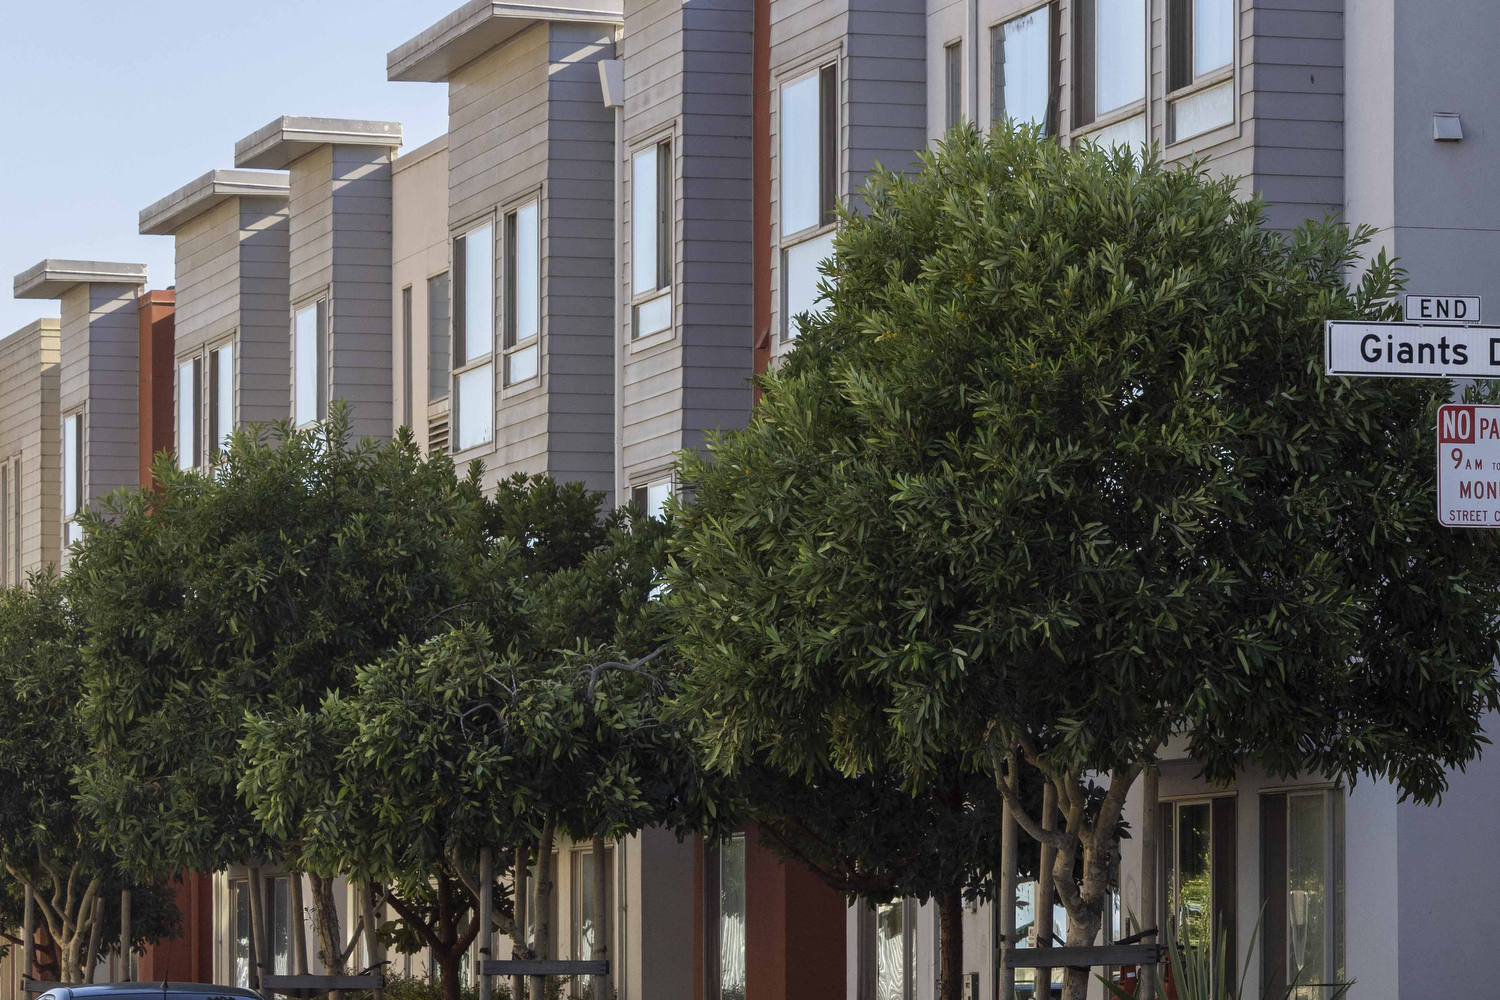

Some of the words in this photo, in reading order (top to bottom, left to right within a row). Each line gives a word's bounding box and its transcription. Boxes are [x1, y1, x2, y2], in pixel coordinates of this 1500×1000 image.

[1420, 298, 1467, 319] END
[1360, 333, 1469, 366] Giants
[1443, 409, 1471, 440] NO
[1449, 509, 1488, 522] STREET
